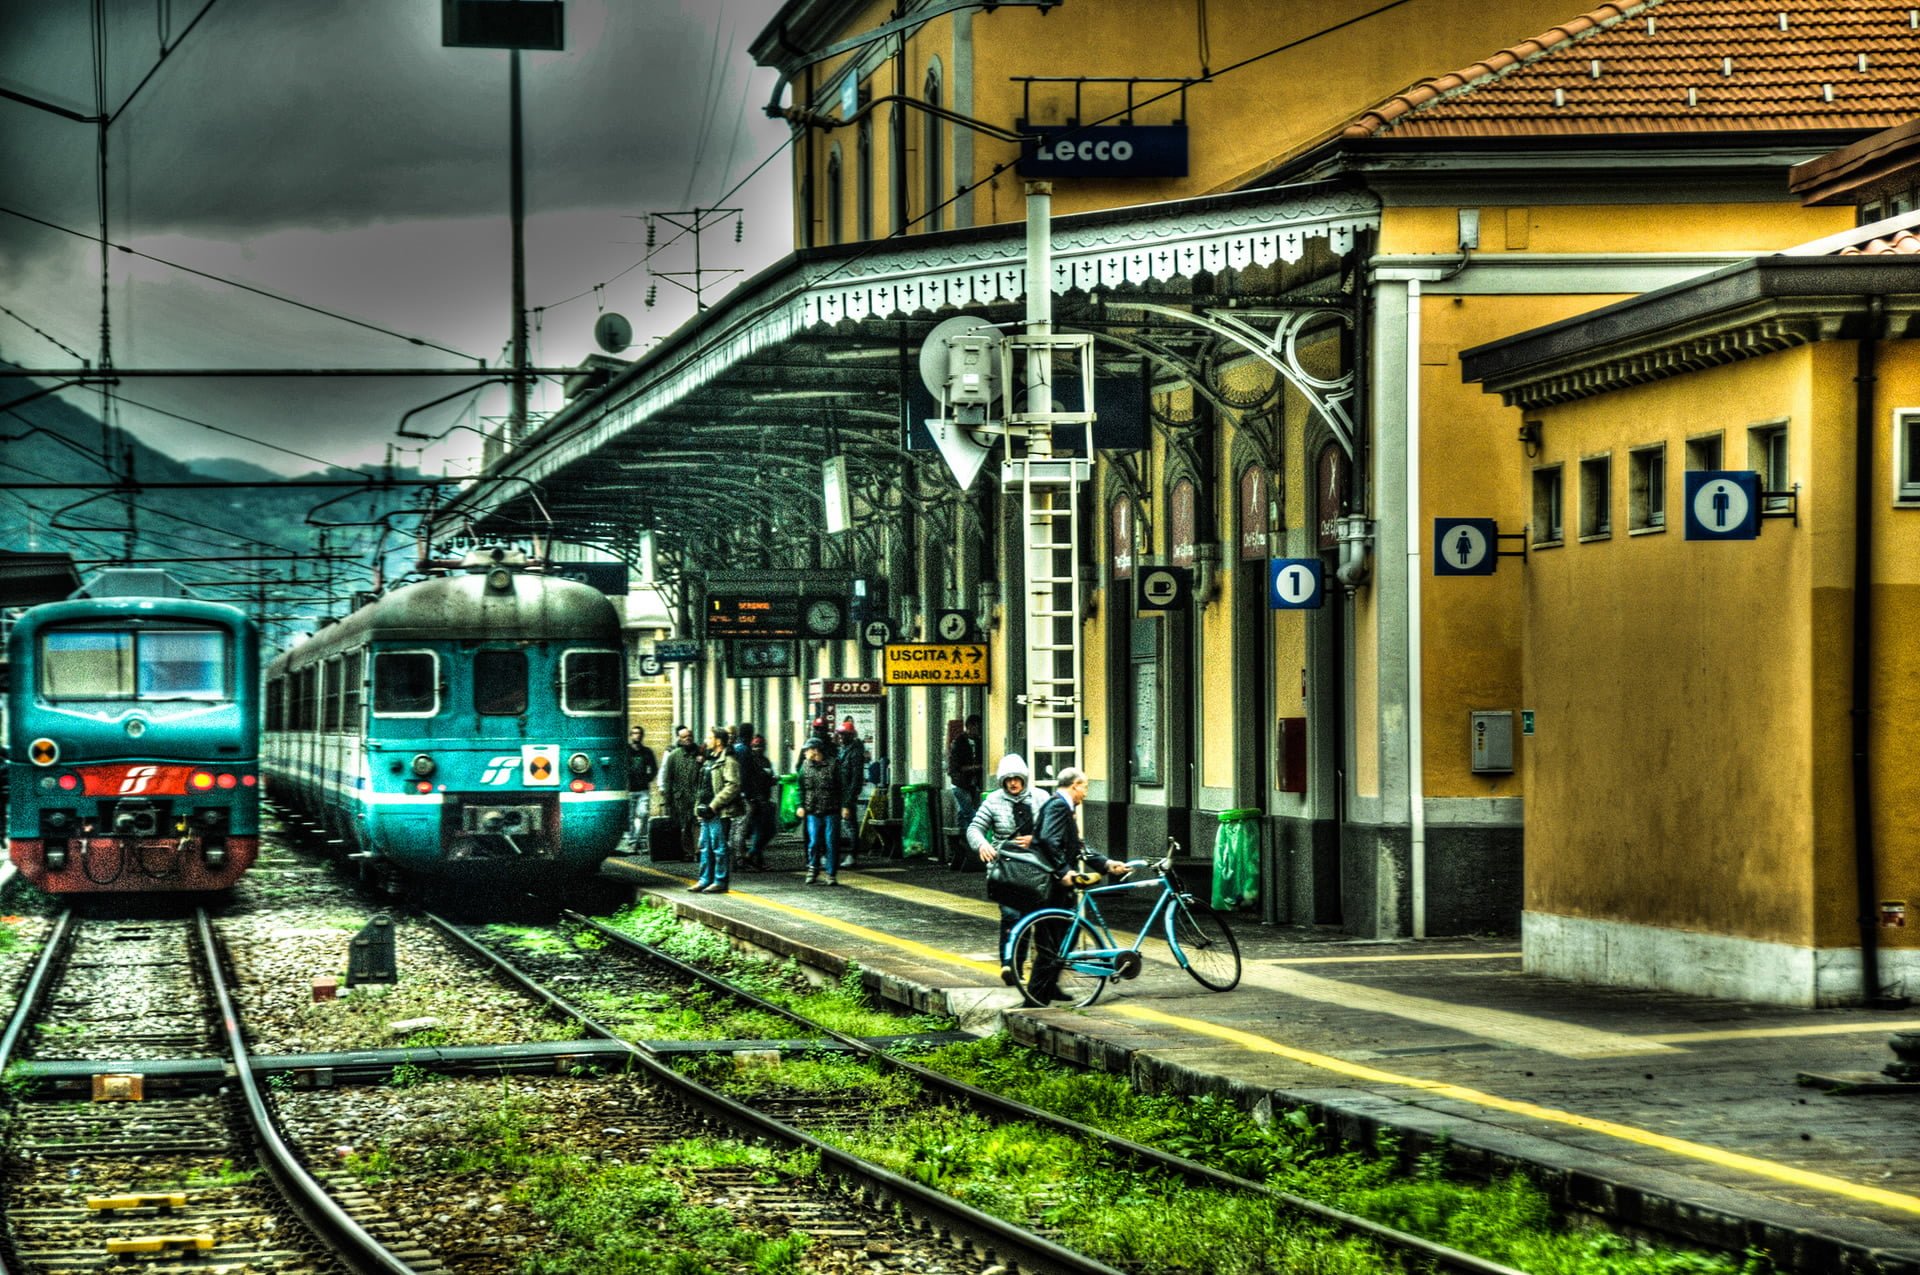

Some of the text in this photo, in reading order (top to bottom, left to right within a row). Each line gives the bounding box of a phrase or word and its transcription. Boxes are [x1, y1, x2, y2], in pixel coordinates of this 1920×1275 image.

[1037, 137, 1133, 161] Lecco
[1290, 572, 1300, 596] 1
[713, 600, 720, 610] 1
[890, 649, 948, 661] USCITA
[892, 669, 981, 681] BINARIO 2,3,4,5
[833, 683, 871, 692] FOTO
